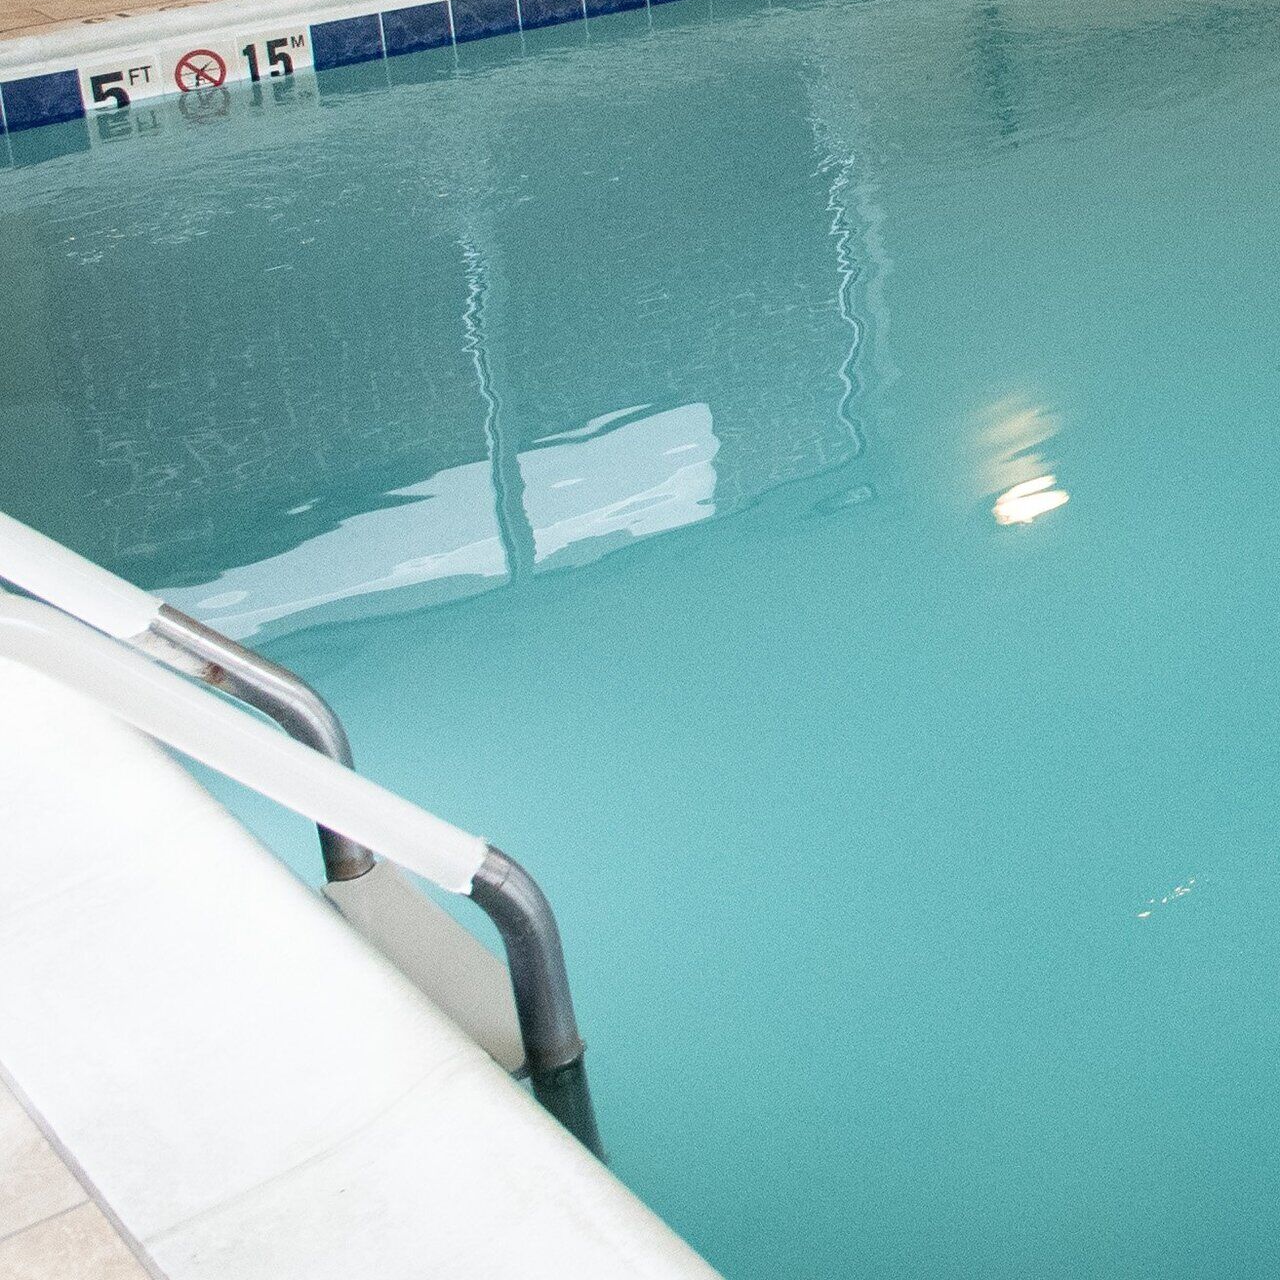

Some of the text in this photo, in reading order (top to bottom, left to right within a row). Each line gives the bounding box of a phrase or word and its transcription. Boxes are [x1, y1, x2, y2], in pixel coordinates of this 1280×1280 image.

[90, 70, 130, 108] 5
[128, 65, 152, 86] FT
[291, 35, 305, 49] M
